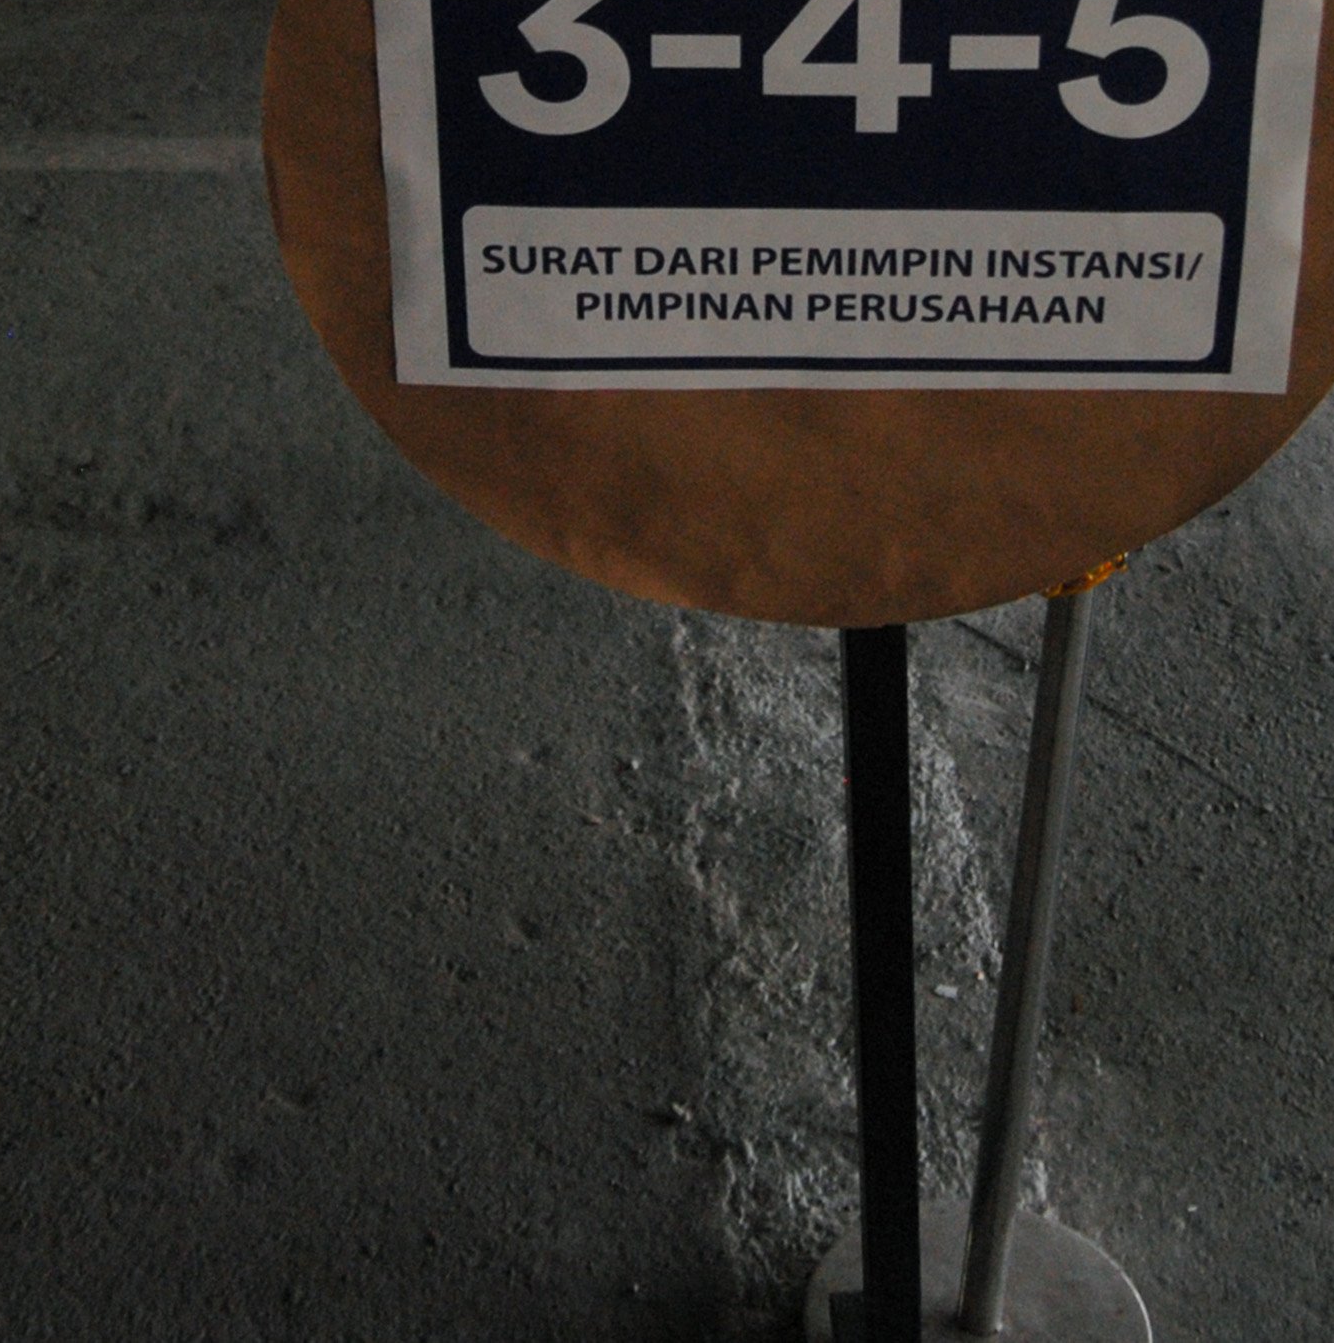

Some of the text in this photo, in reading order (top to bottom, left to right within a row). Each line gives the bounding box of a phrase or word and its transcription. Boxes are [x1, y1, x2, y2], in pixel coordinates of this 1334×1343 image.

[482, 244, 1204, 282] SURAT DARI PEMIMPIN INSTANSI/
[576, 292, 1106, 324] PIMPINAN PERUSAHAAN
